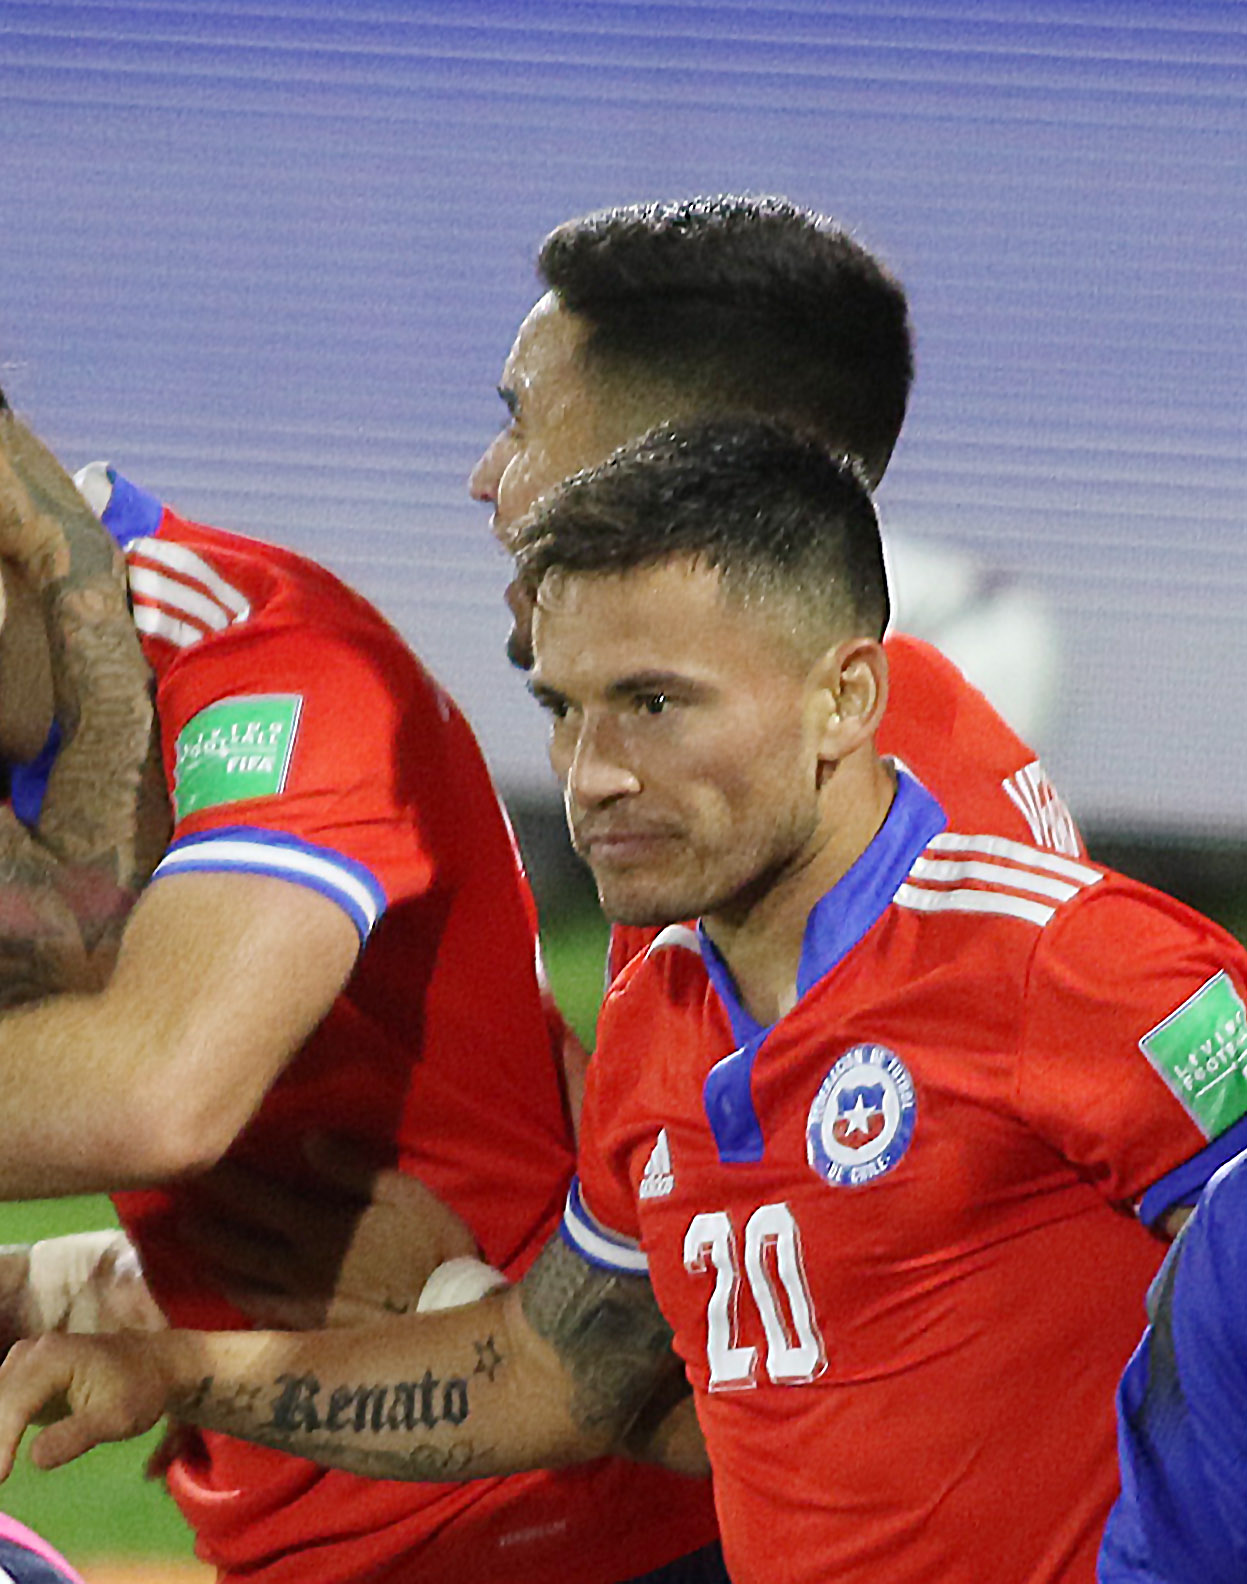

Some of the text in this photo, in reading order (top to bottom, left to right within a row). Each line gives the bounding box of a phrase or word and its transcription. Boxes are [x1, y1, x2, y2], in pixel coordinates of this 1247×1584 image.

[226, 755, 273, 774] FIFA
[683, 1201, 829, 1393] 20
[265, 1367, 470, 1433] Renato
